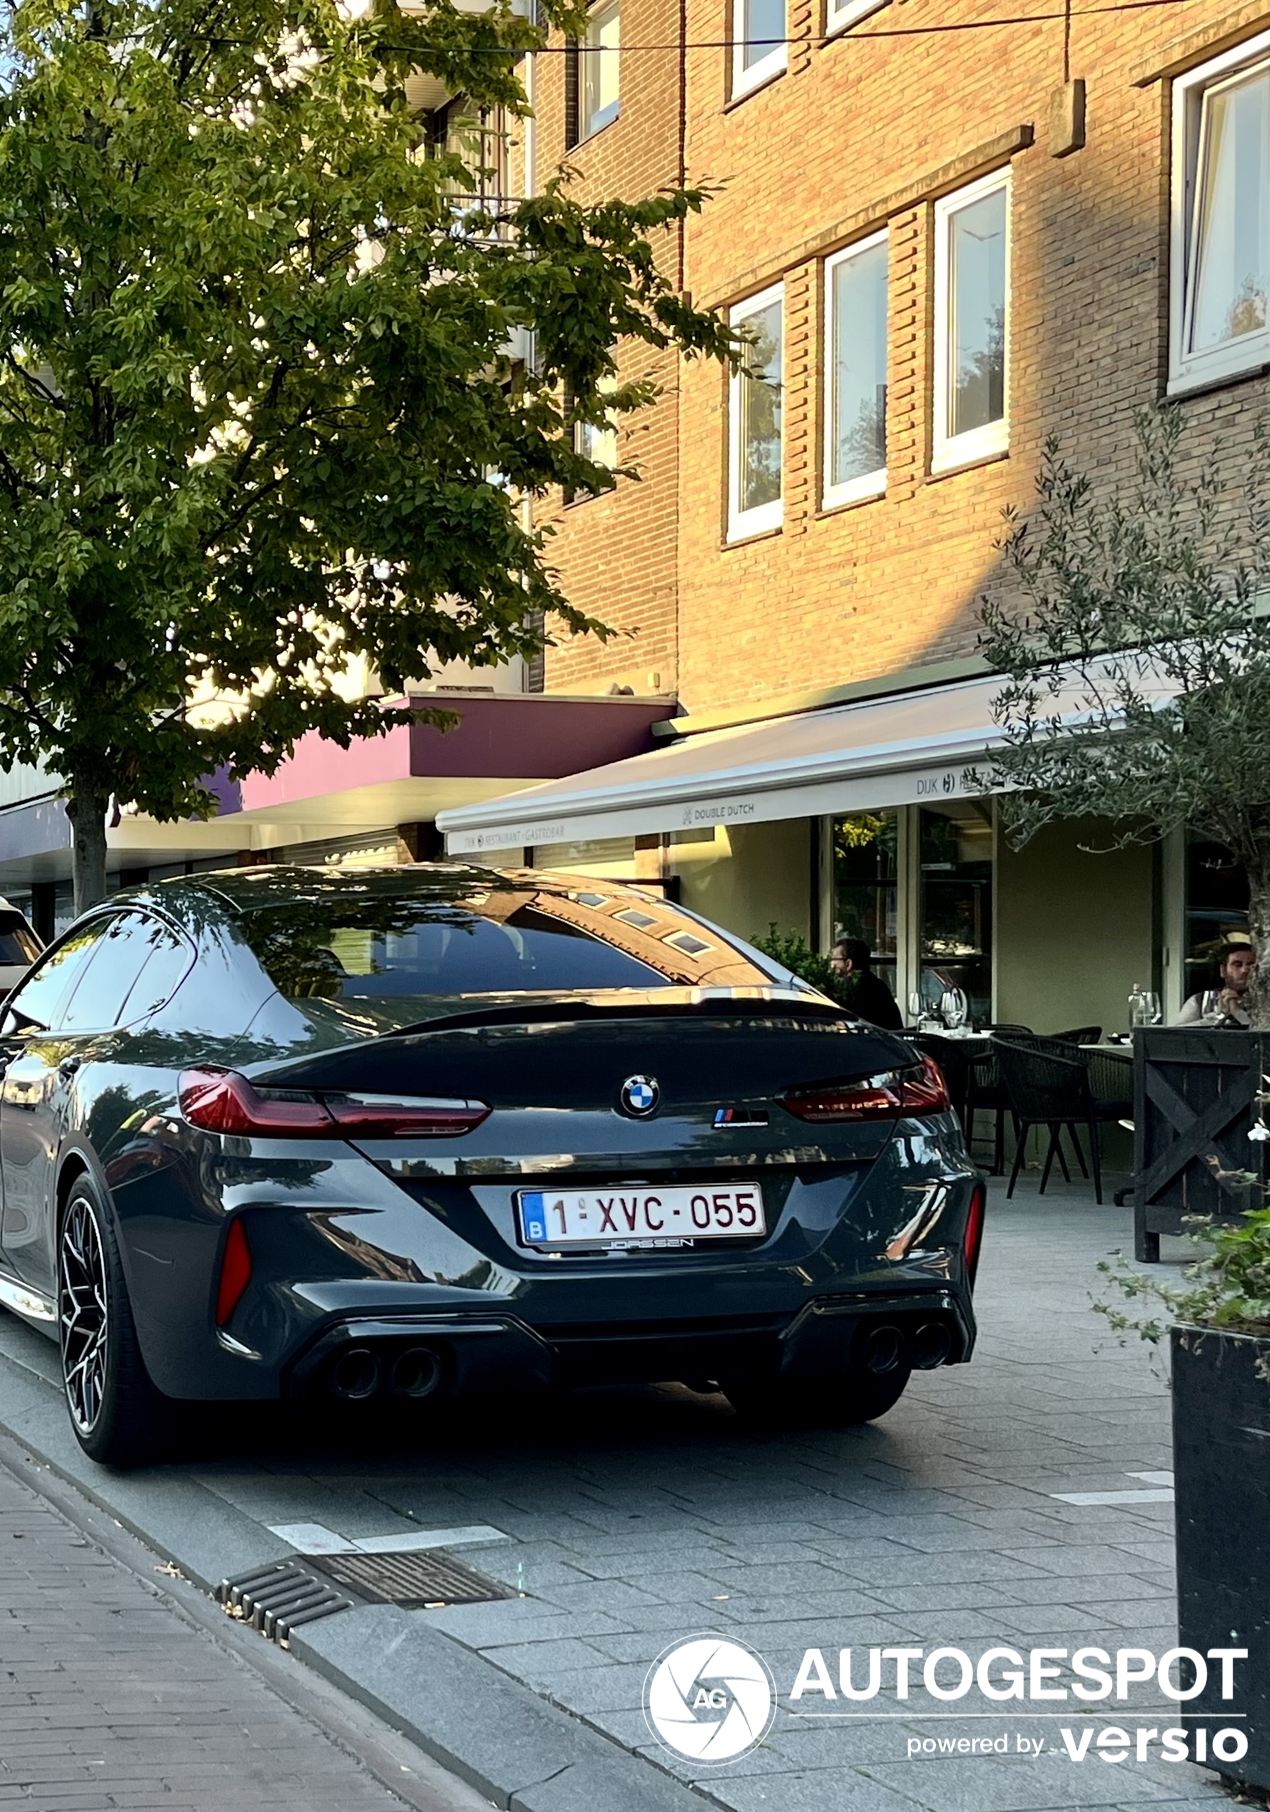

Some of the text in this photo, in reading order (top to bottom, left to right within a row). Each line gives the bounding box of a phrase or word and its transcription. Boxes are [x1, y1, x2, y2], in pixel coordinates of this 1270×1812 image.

[916, 777, 938, 795] DIJK
[694, 803, 755, 820] DOUBLE DUTCH
[485, 830, 521, 846] RESTAURANT
[525, 825, 565, 841] GASTROBAR
[529, 1221, 543, 1238] B
